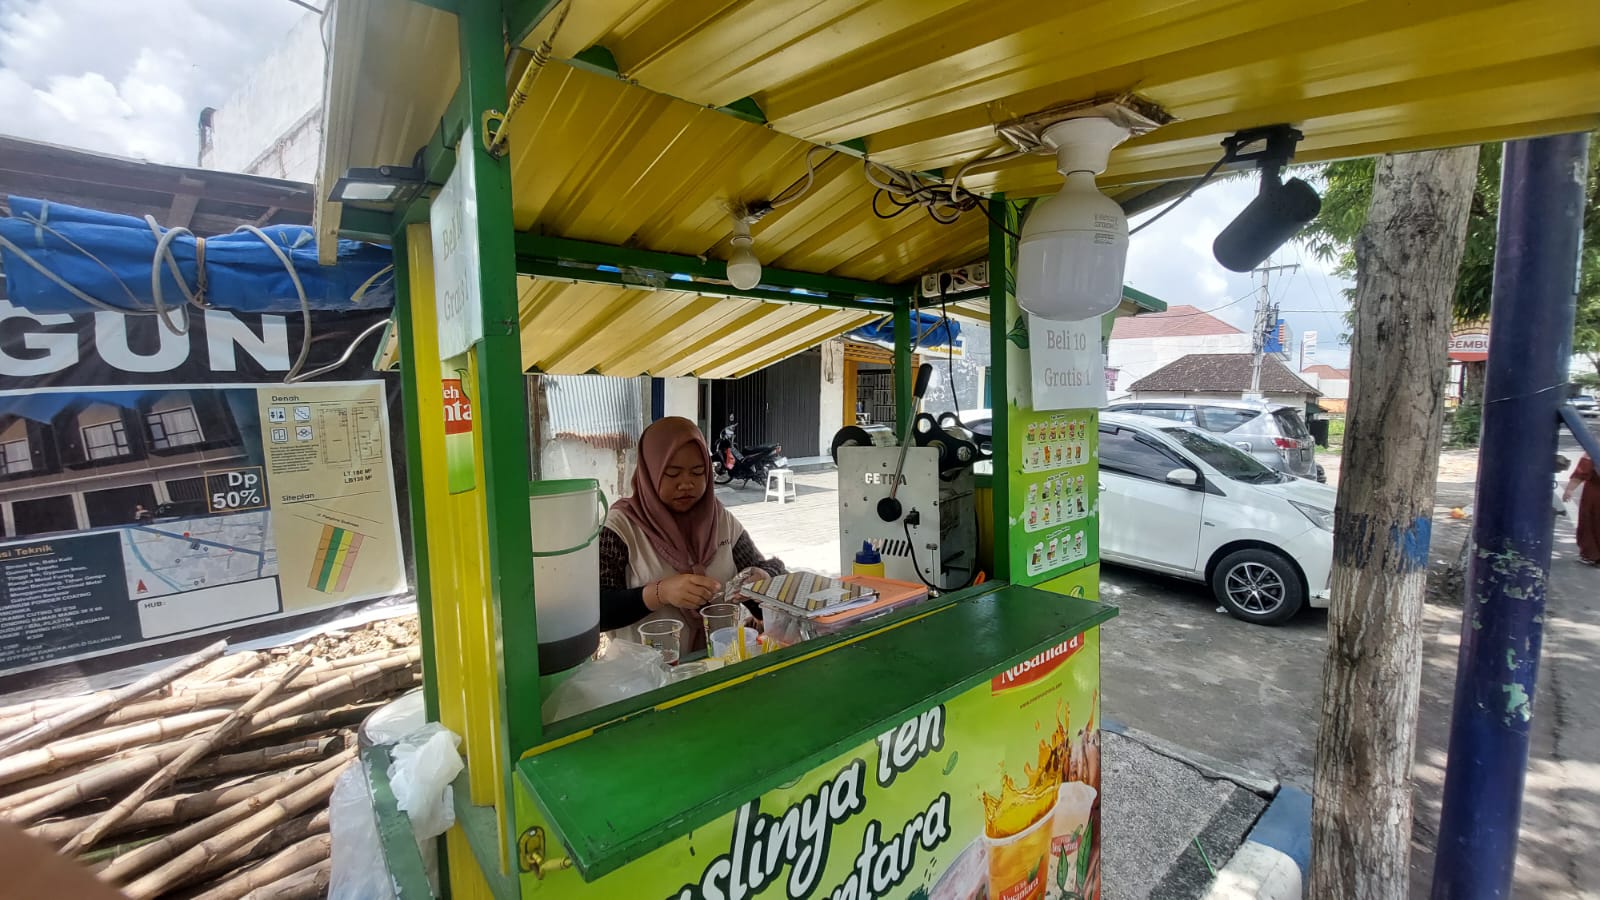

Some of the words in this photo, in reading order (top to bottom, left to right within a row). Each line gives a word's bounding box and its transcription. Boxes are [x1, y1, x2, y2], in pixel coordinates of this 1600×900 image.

[1047, 330, 1070, 350] Beli
[1073, 333, 1086, 351] 10
[1044, 368, 1082, 387] Gratis
[228, 472, 258, 488] Dp
[213, 489, 260, 509] 50%
[281, 493, 315, 502] Siteplan
[14, 545, 53, 556] Teknik
